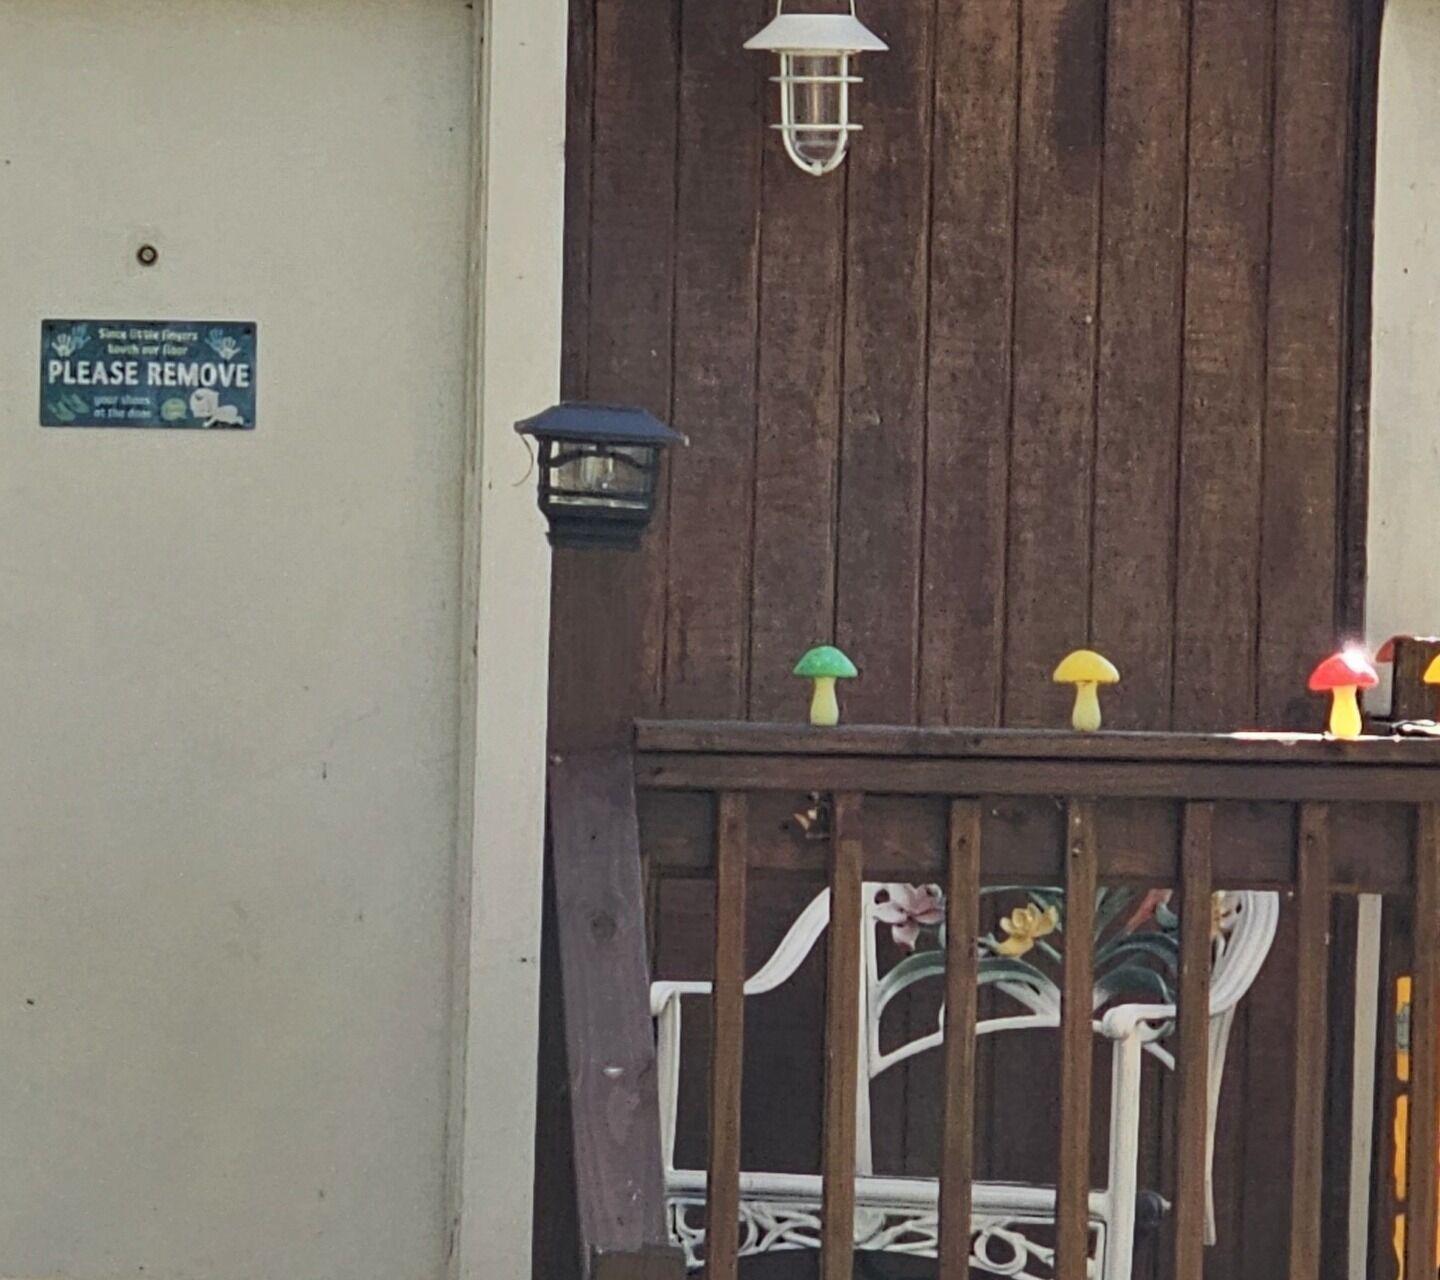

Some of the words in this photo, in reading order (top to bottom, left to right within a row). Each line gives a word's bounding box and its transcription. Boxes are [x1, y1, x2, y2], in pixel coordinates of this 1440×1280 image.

[98, 328, 127, 340] Since
[129, 328, 159, 341] little
[161, 329, 199, 343] fingers
[107, 344, 139, 355] touch
[141, 346, 159, 356] our
[48, 360, 138, 385] PLEASE
[147, 362, 250, 388] REMOVE
[93, 407, 106, 418] at
[107, 407, 125, 418] the
